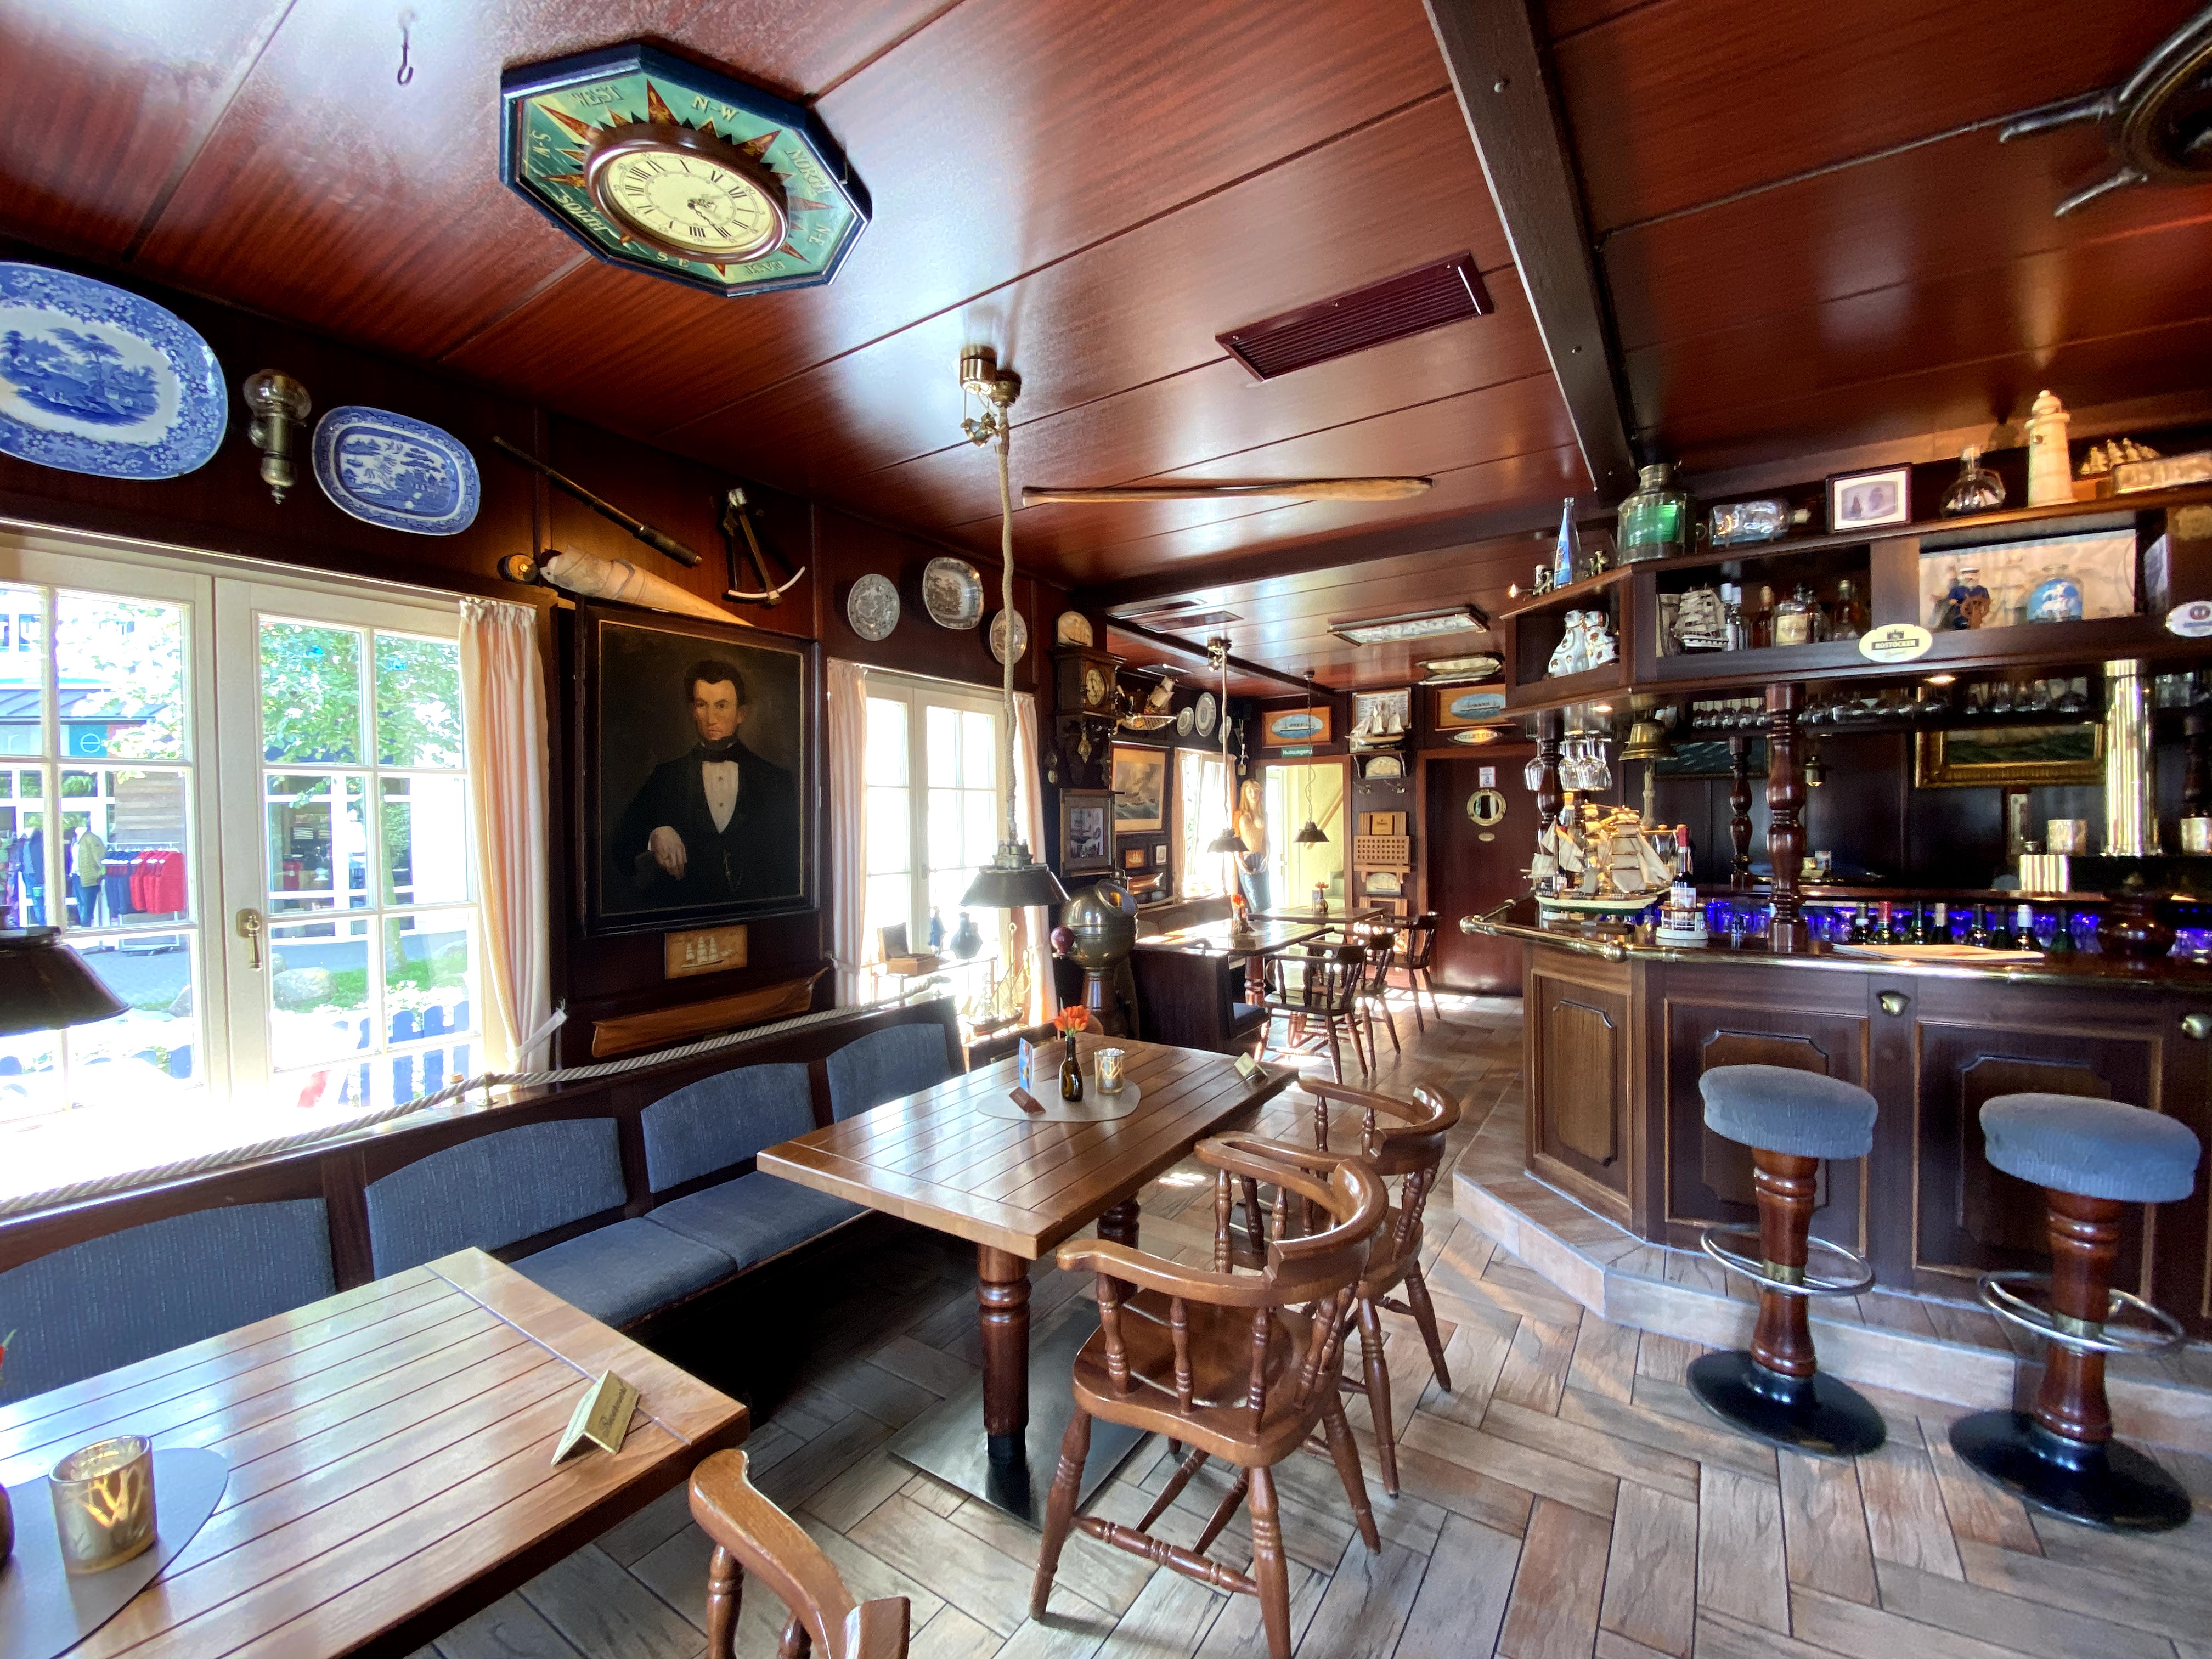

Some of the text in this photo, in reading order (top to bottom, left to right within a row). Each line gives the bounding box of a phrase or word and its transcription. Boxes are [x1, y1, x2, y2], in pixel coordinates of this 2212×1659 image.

[571, 84, 624, 107] WEST
[784, 149, 833, 197] NORTH
[557, 194, 608, 231] SOUTH
